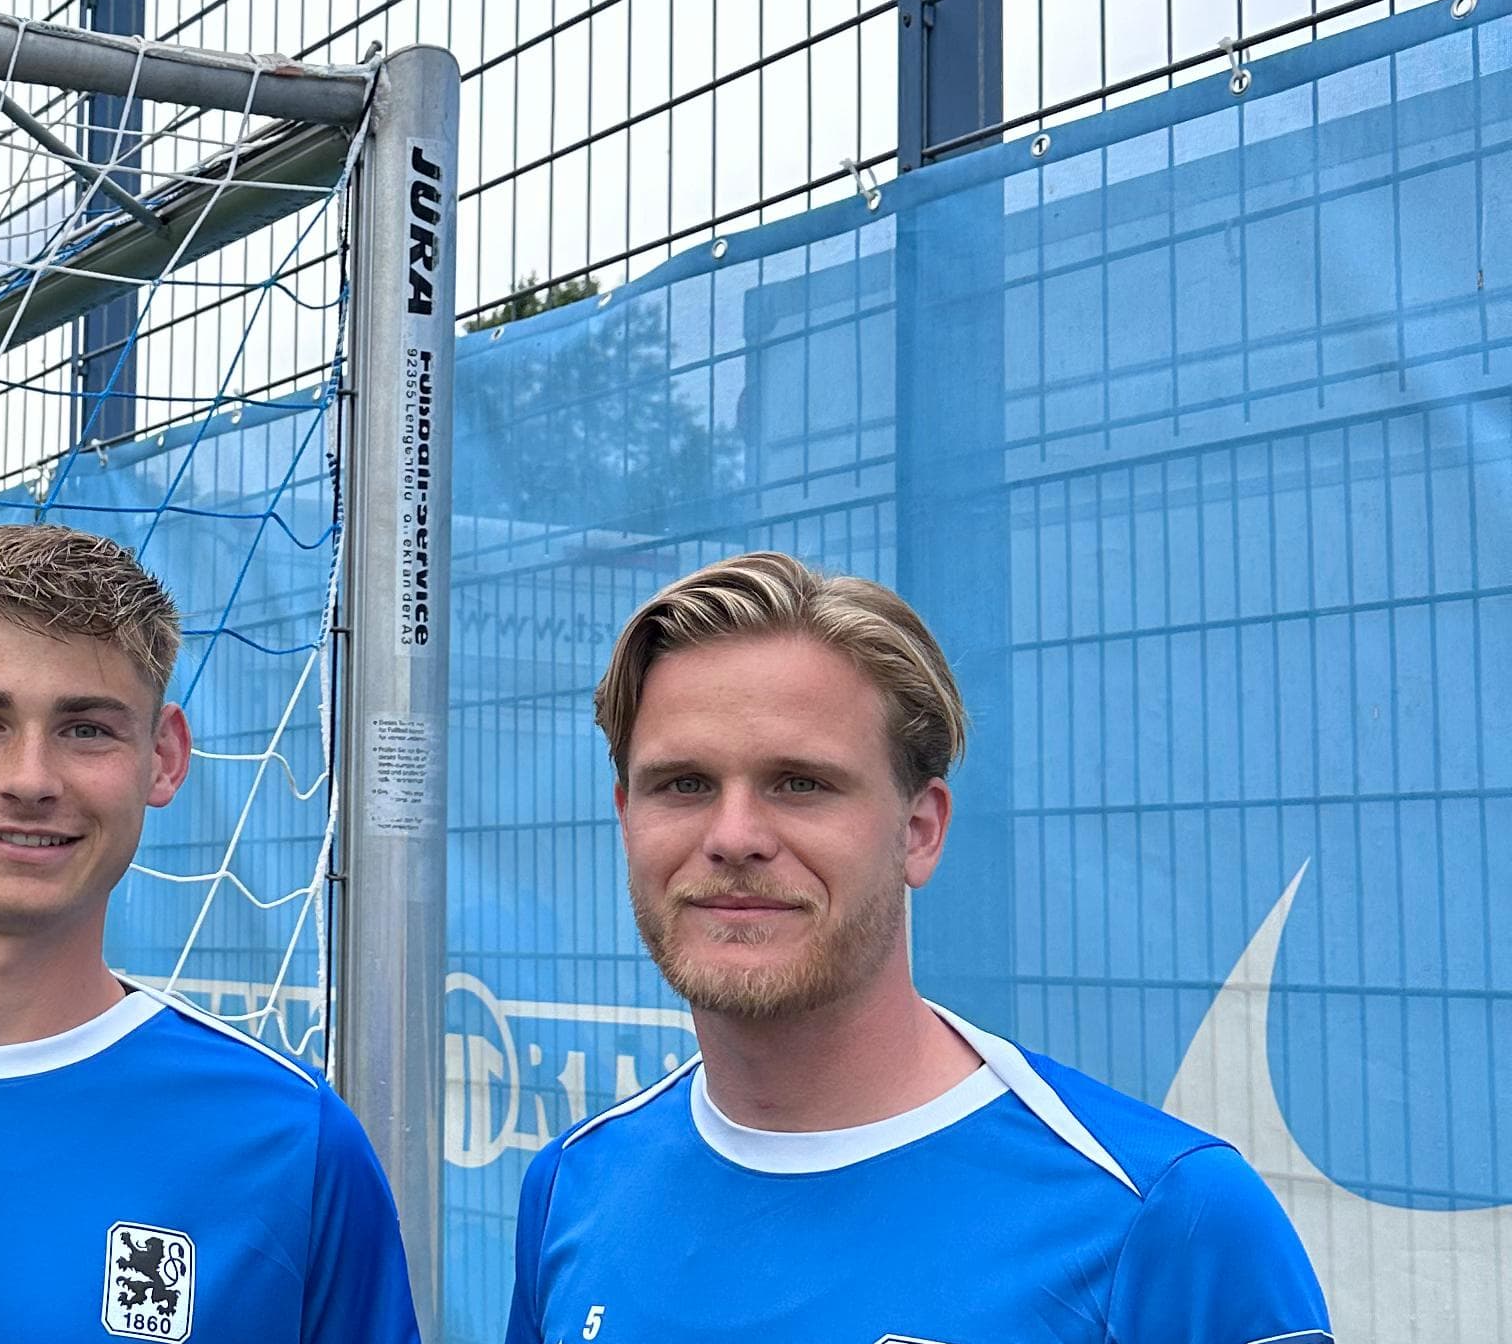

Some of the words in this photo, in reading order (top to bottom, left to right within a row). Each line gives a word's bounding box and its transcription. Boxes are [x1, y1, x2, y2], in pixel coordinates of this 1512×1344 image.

[407, 145, 442, 315] JURA
[405, 347, 418, 400] 92355
[402, 592, 413, 620] der
[401, 623, 413, 645] A3
[123, 1311, 173, 1336] 1860
[582, 1305, 606, 1341] 5
